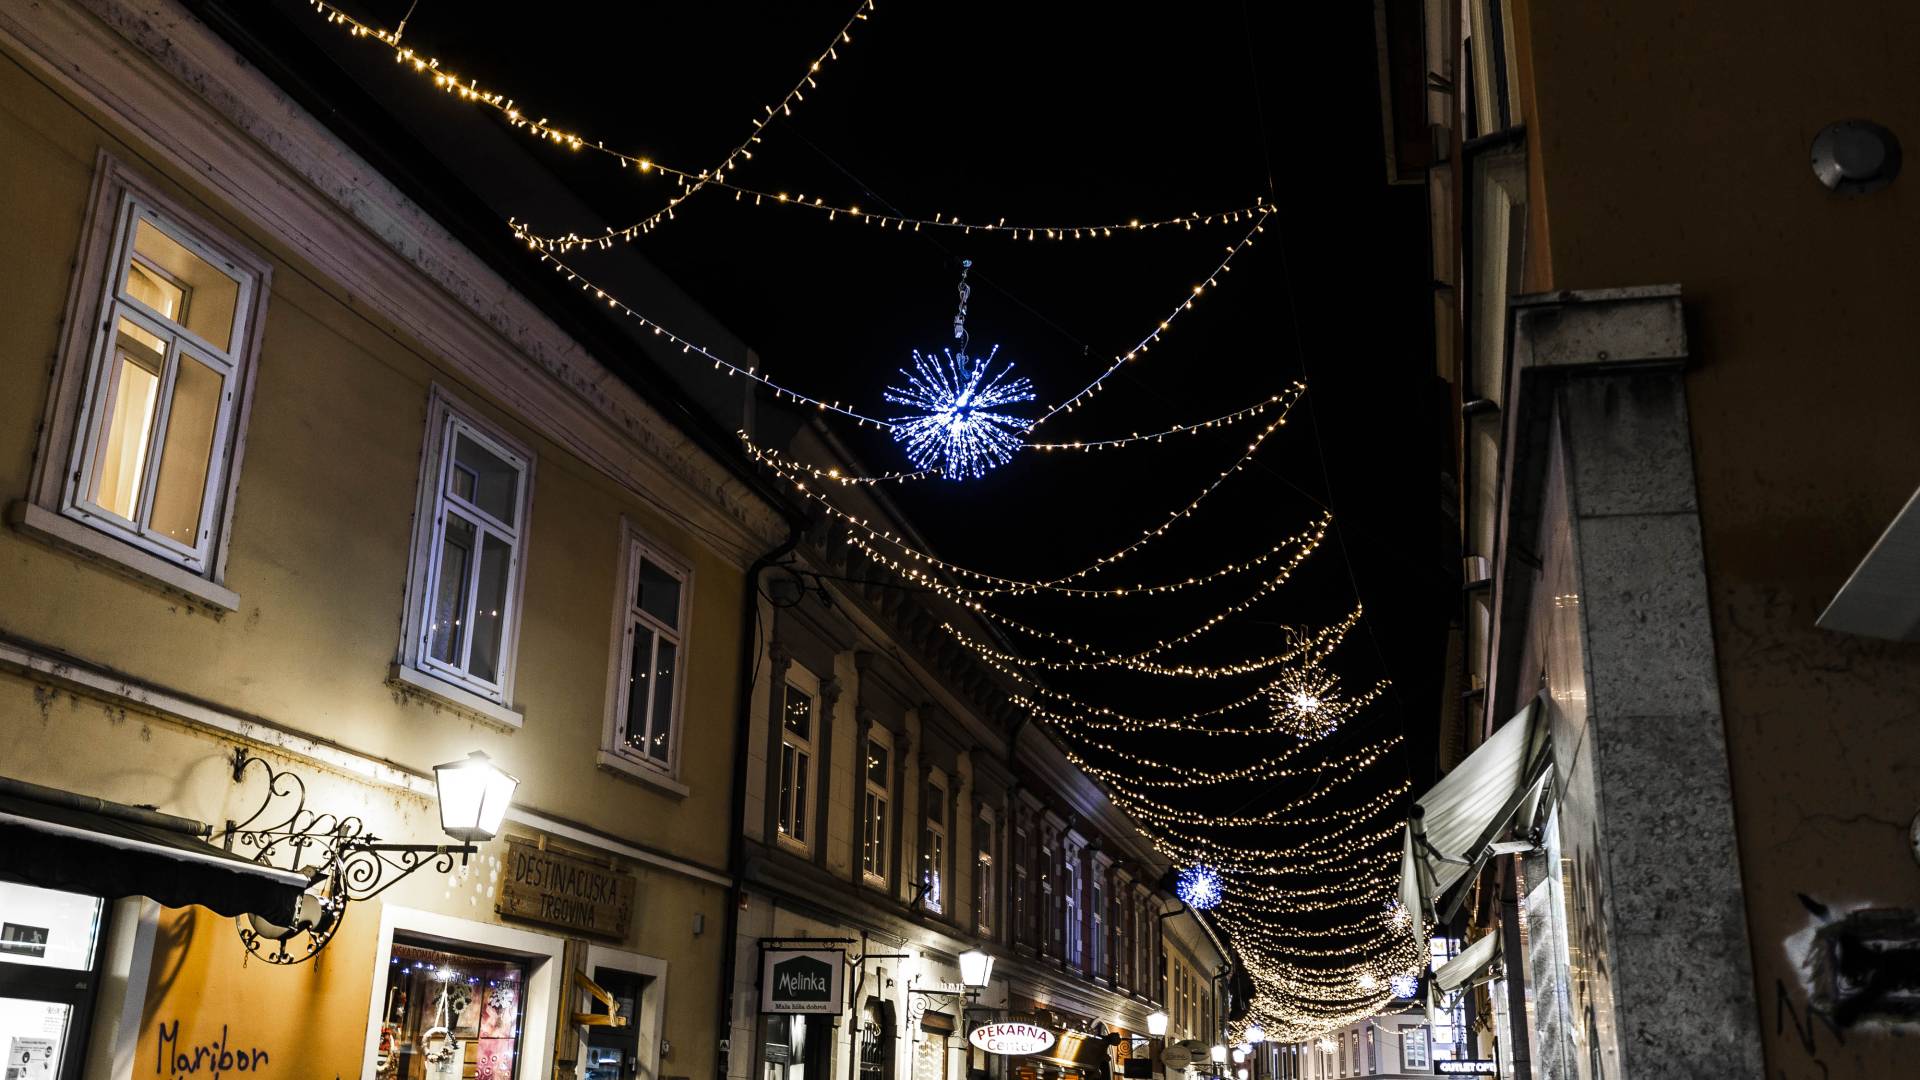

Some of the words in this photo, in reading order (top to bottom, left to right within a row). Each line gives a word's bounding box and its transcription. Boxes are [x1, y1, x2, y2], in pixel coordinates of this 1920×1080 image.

[515, 853, 617, 905] DESTINACIJSKA
[540, 893, 595, 928] TRGOVINA
[779, 972, 826, 996] Melinka
[977, 1024, 1047, 1044] PEKARNA
[987, 1039, 1034, 1052] Center
[156, 1019, 269, 1075] Maribor
[1440, 1062, 1475, 1073] OUTLET
